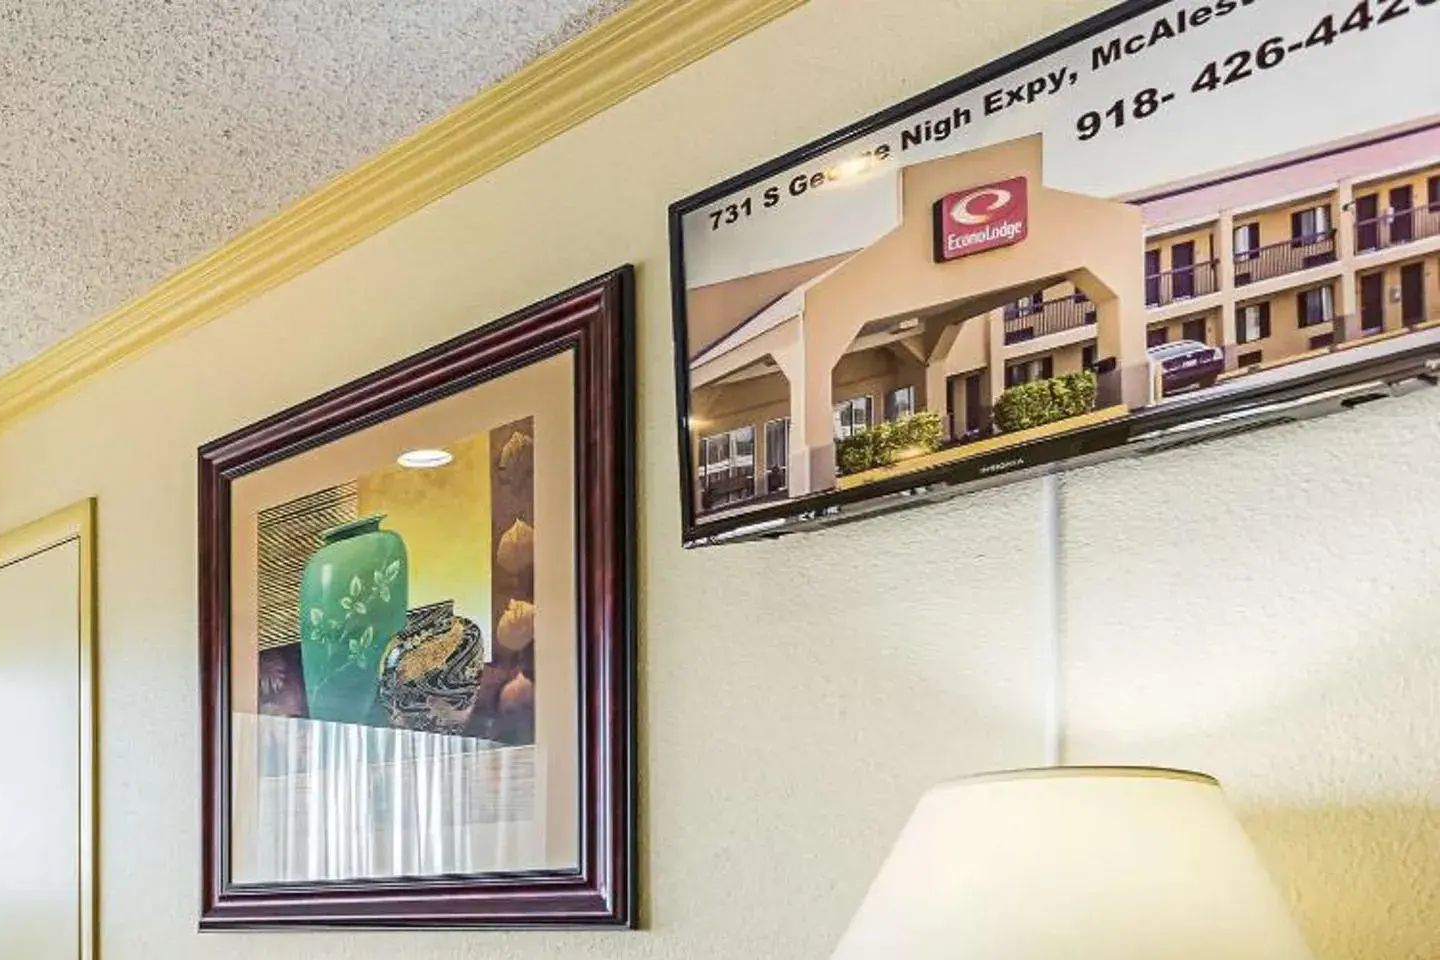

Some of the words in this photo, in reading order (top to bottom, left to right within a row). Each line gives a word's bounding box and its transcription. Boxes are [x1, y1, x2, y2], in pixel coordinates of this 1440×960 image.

[709, 197, 753, 231] 731
[763, 186, 781, 209] S
[789, 143, 891, 197] Gee
[901, 107, 972, 151] Nigh
[982, 66, 1078, 116] Expy,
[1090, 0, 1257, 71] McAles
[1075, 87, 1175, 141] 918-
[1190, 0, 1438, 94] 426-442
